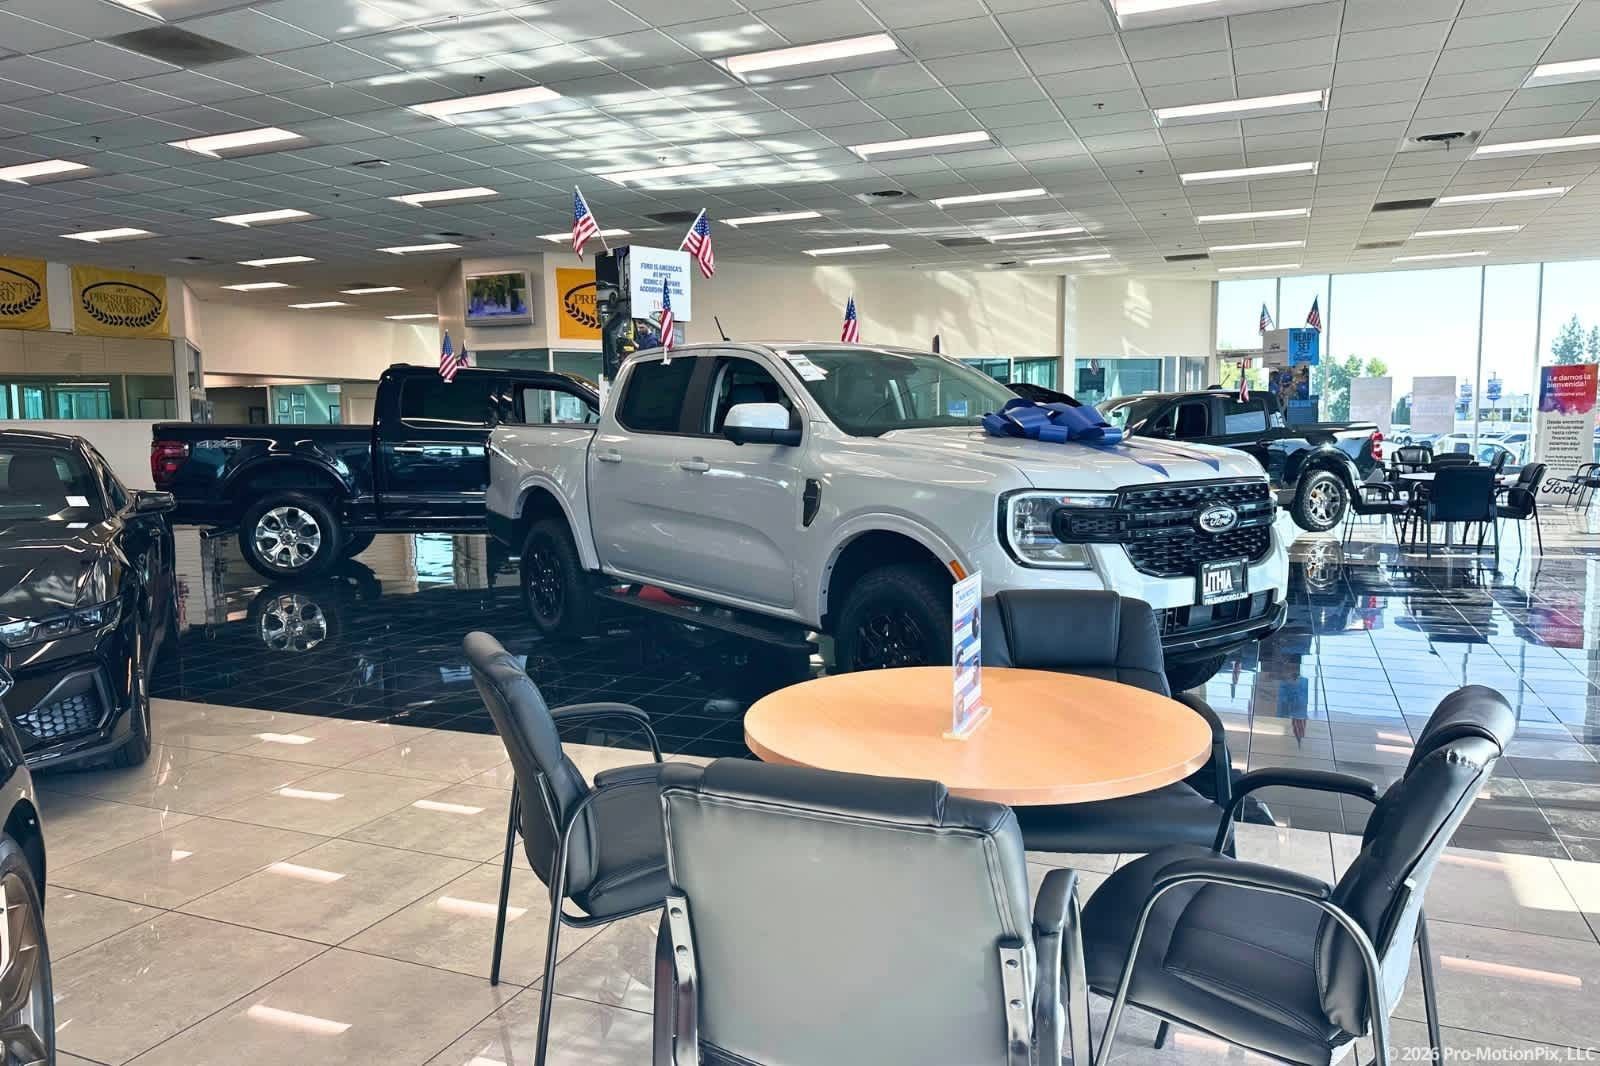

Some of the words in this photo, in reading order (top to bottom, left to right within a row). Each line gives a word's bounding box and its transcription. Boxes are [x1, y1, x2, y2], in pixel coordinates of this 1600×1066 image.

[106, 303, 142, 316] AWARD
[1298, 341, 1311, 352] SET
[1541, 477, 1581, 496] Ford
[1203, 569, 1233, 593] LITHIA
